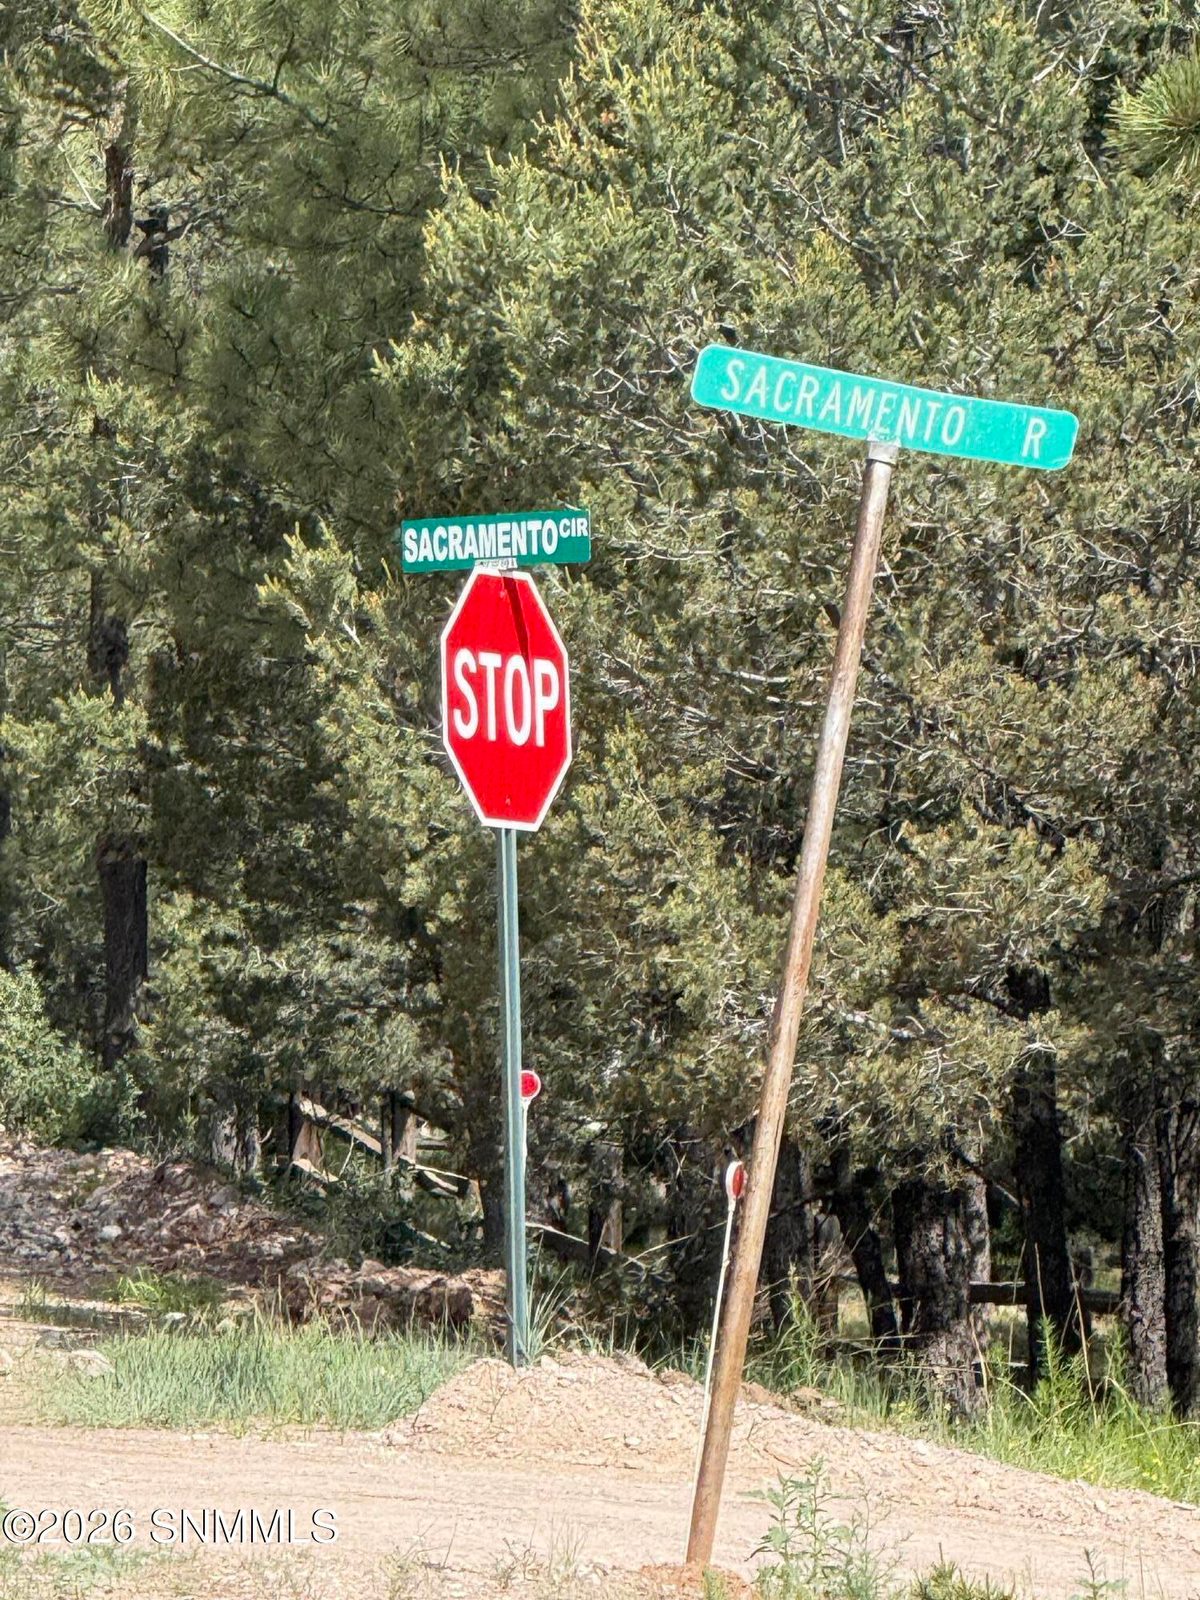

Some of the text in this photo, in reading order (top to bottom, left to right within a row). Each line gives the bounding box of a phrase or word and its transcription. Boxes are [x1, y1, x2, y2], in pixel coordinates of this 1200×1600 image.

[720, 359, 966, 446] SACRAMENTO
[404, 517, 588, 563] SACRAMENTO CIR
[453, 647, 560, 748] STOP
